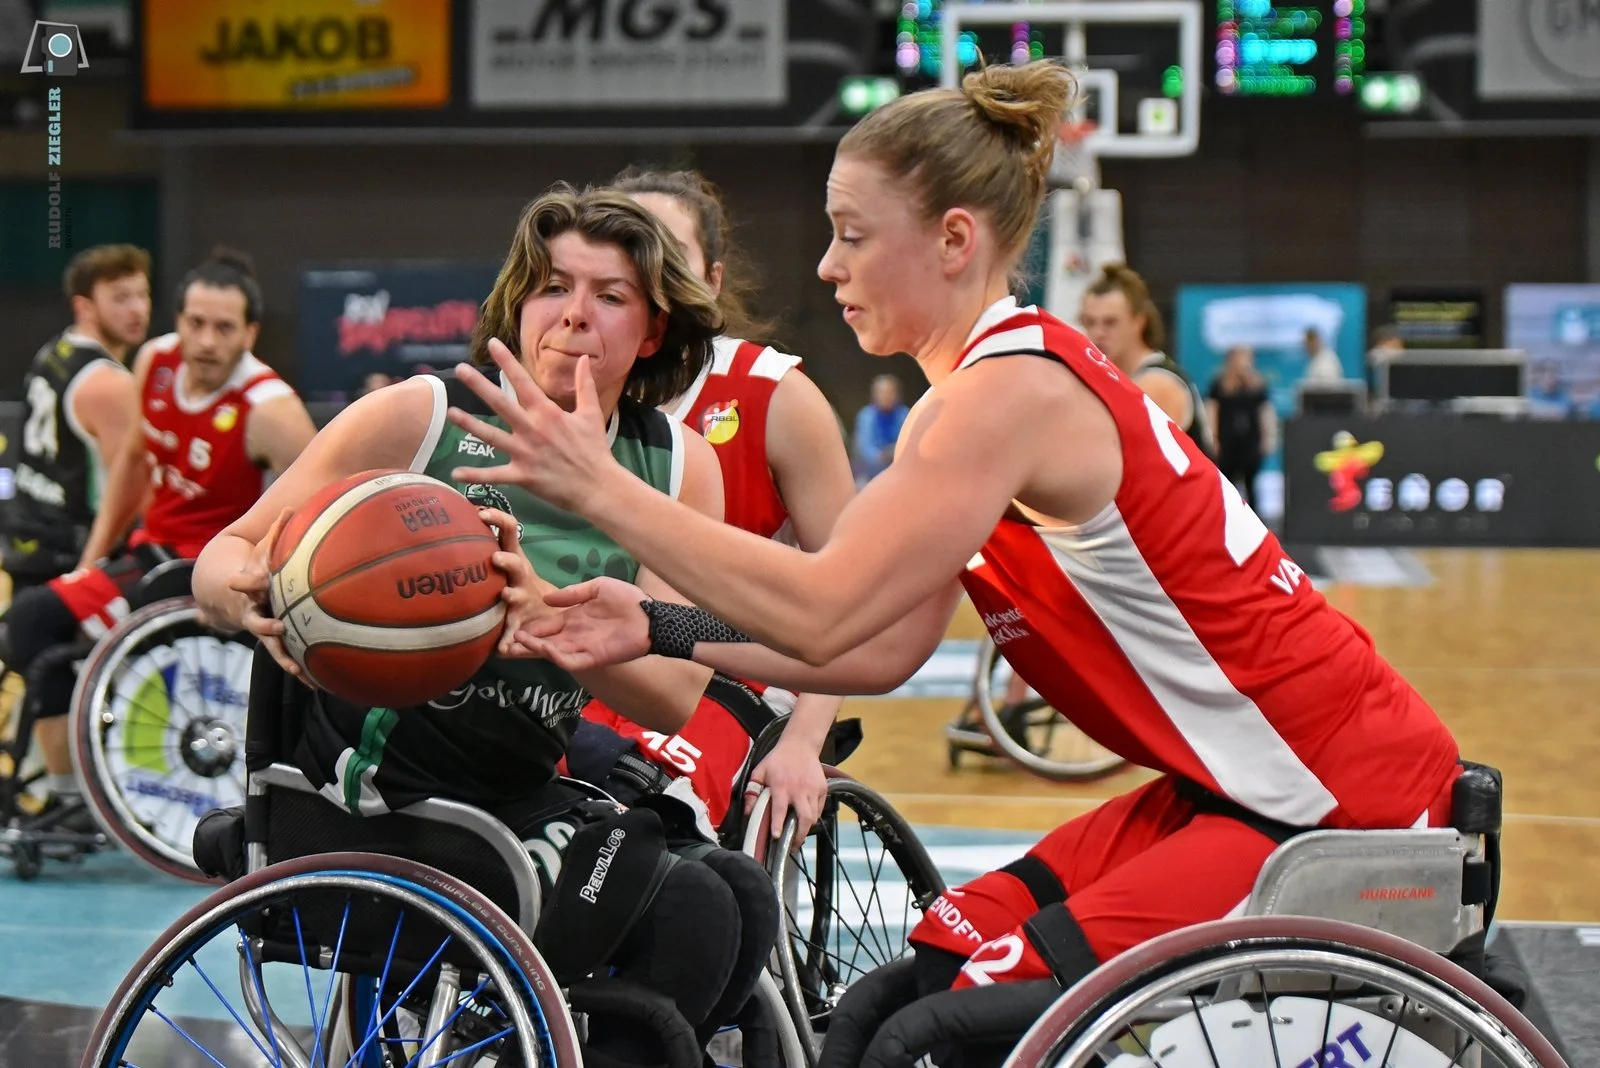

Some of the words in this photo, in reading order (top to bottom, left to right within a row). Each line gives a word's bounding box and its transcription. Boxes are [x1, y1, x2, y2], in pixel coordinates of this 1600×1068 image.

[201, 17, 391, 62] JAKOB
[457, 440, 496, 459] PEAK
[400, 506, 451, 533] FIBA
[396, 560, 489, 600] molten
[641, 730, 703, 774] 15
[413, 871, 492, 918] SCHWALBE
[1359, 886, 1437, 900] HURRICANE
